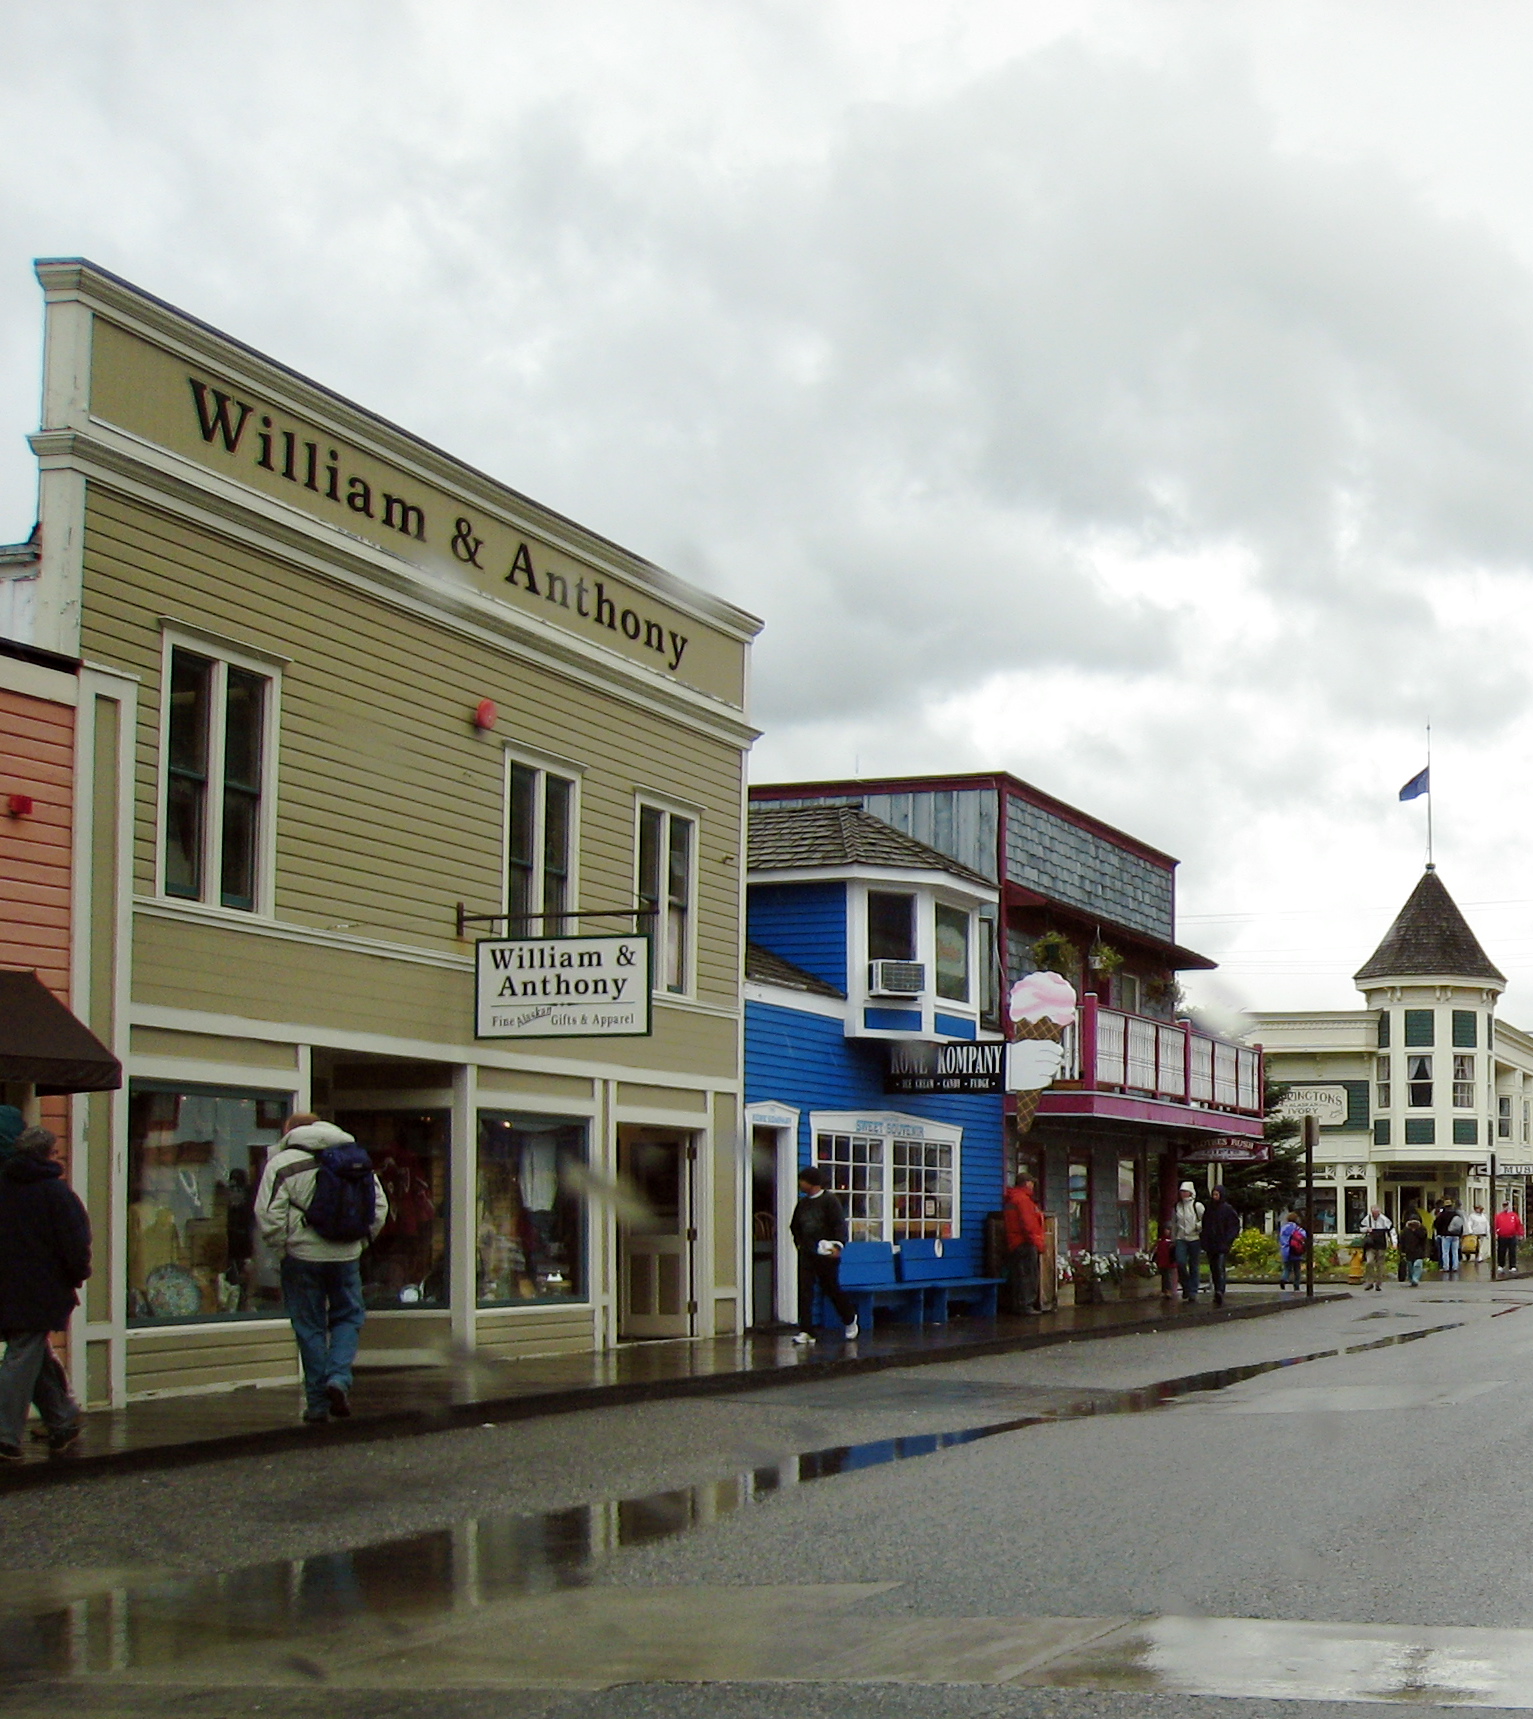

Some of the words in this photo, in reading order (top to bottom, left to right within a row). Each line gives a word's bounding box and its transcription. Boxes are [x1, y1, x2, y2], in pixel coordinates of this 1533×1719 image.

[189, 376, 427, 543] William
[450, 517, 485, 571] &
[504, 543, 689, 671] Anthony
[490, 945, 603, 970] William
[616, 944, 636, 967] &
[498, 973, 628, 1000] Anthony
[492, 1015, 515, 1028] Fine
[517, 1006, 552, 1028] Alaskan
[551, 1013, 577, 1026] Gifts
[580, 1014, 588, 1025] &
[592, 1013, 635, 1028] Apparel
[937, 1045, 1003, 1074] KOMPANY
[1284, 1091, 1343, 1106] RINGTONS
[1288, 1107, 1319, 1115] IVORY
[856, 1119, 884, 1134] SWEET
